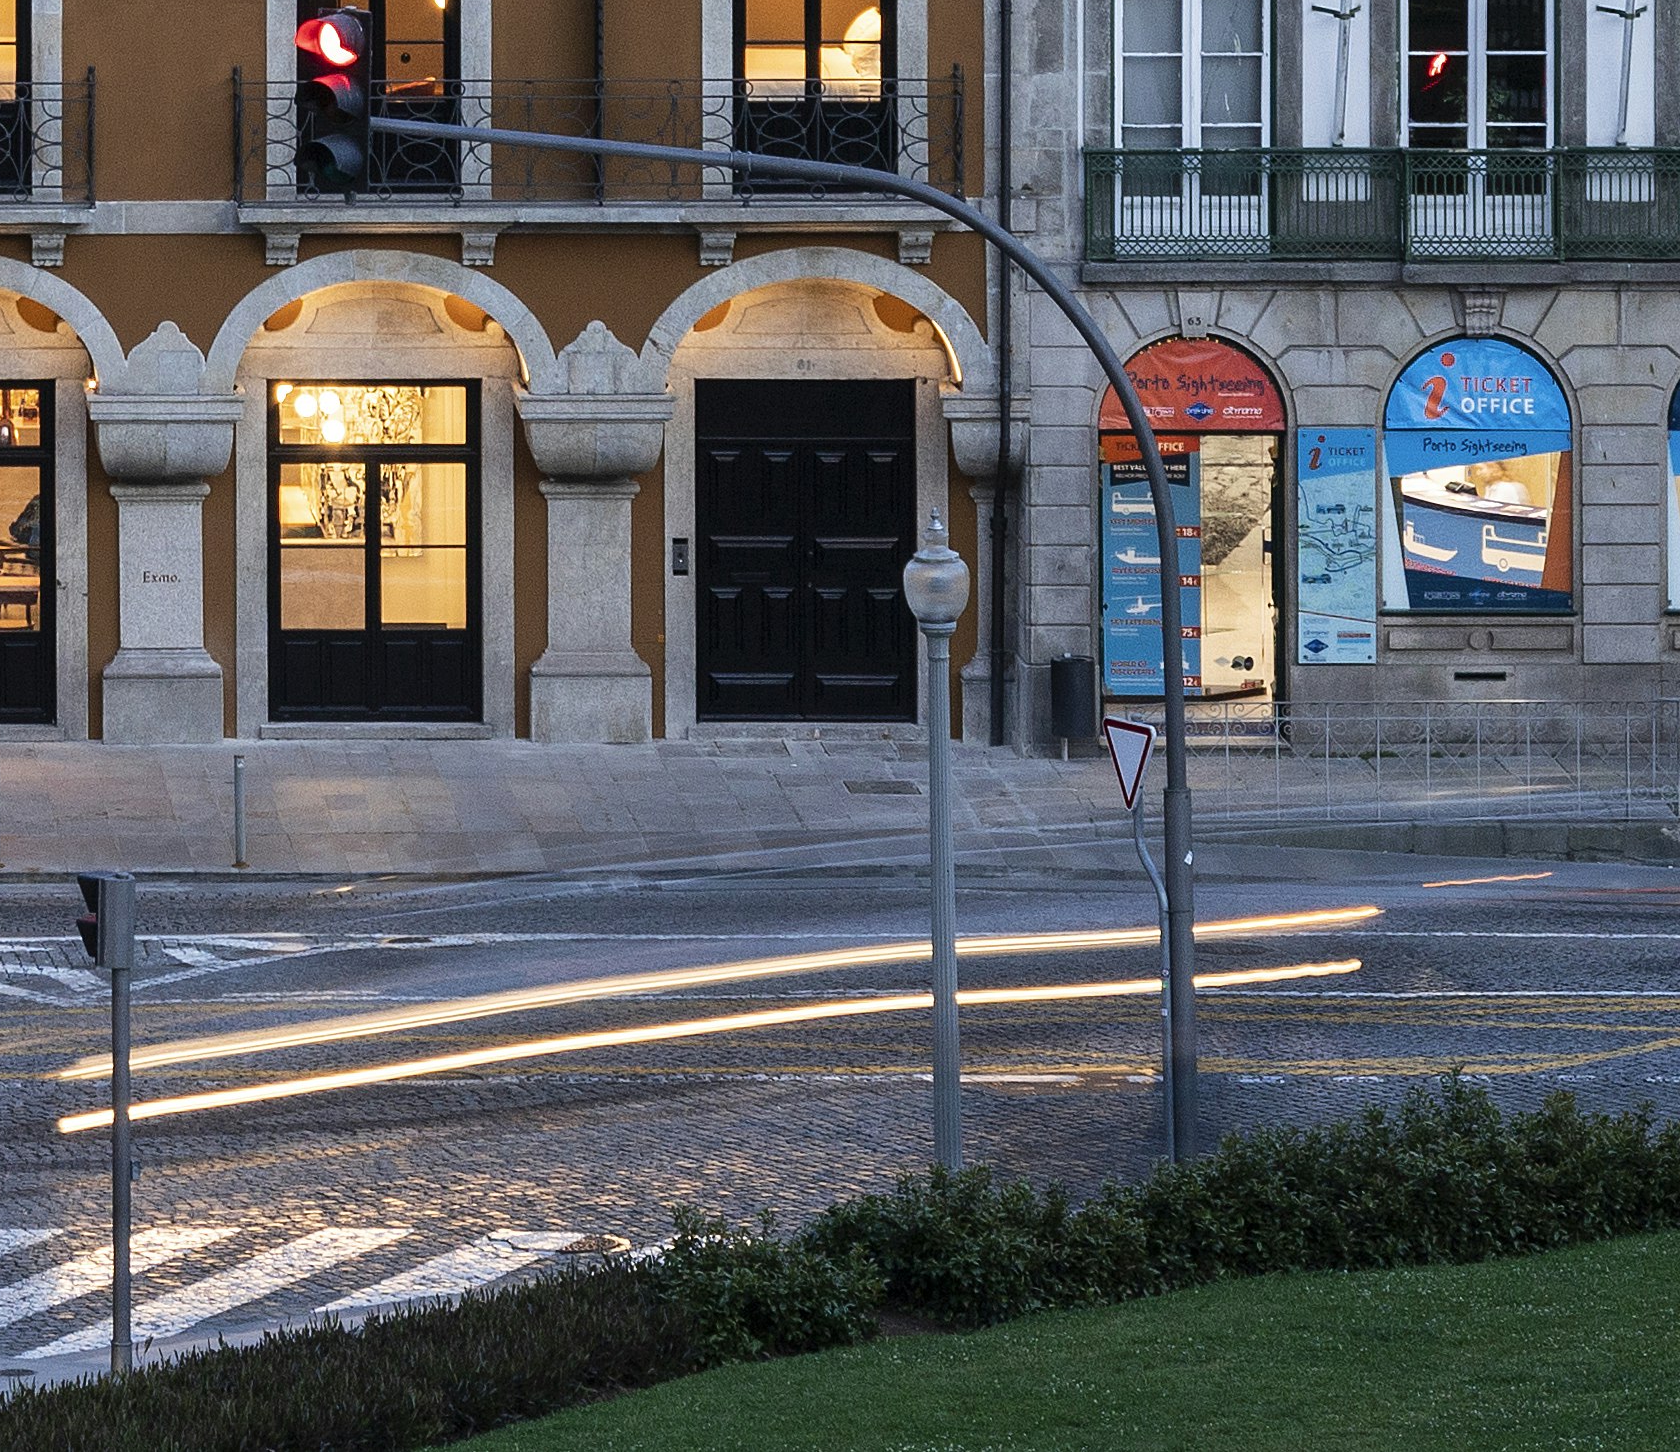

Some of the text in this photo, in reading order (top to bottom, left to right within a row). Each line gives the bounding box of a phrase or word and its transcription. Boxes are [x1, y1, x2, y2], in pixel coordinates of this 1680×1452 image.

[1187, 317, 1201, 326] 63
[1176, 373, 1265, 397] Sightseeing
[1460, 376, 1532, 393] TICKET
[1461, 397, 1535, 414] OFFICE
[1158, 442, 1185, 452] FFICE
[1328, 447, 1365, 456] TICKET
[1423, 437, 1528, 456] Porto Sightseeing
[1328, 458, 1366, 466] OFFICE
[143, 570, 180, 583] Exmo.
